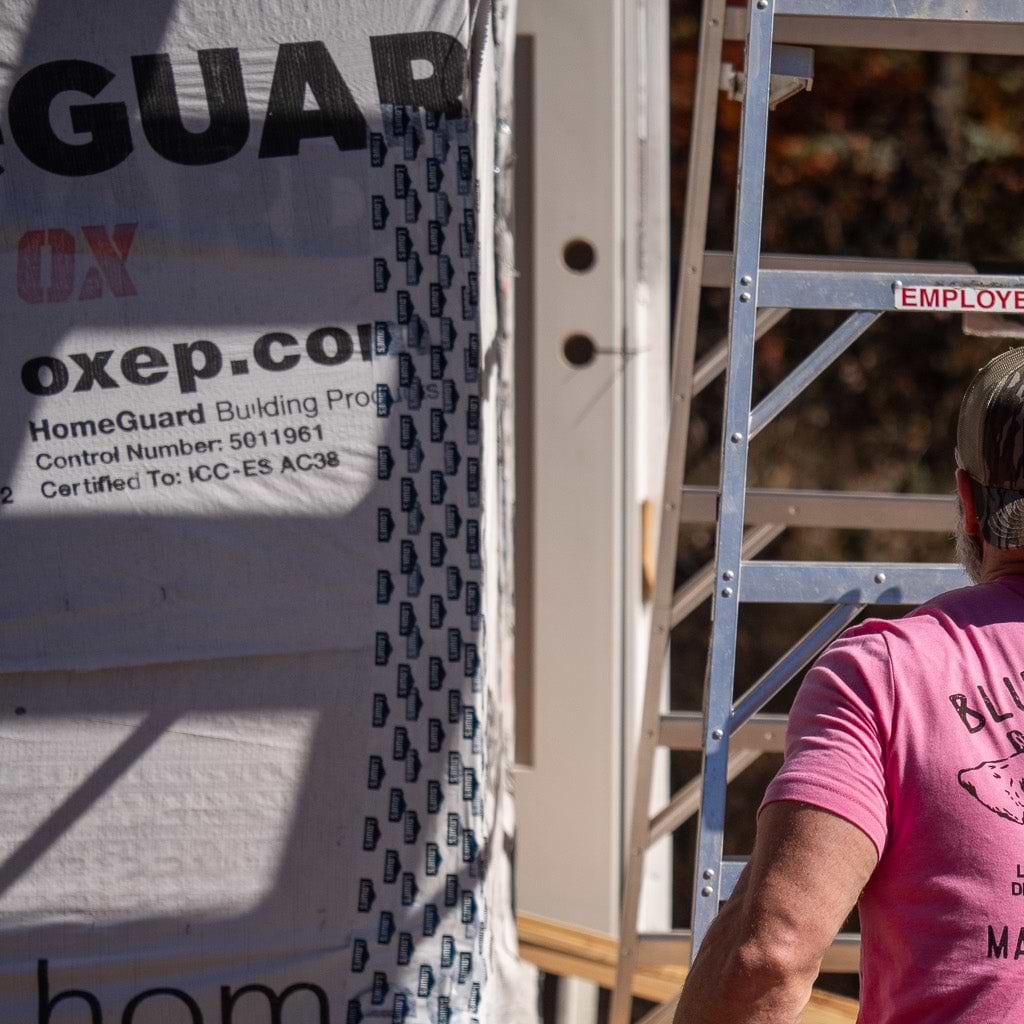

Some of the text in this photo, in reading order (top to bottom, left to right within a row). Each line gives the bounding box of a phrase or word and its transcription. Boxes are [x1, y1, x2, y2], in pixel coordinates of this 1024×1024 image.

[0, 31, 467, 177] GUAR
[16, 222, 138, 303] OX
[29, 403, 206, 442] HomeGuard
[215, 396, 319, 424] Building
[36, 424, 324, 471] Control Number: 5011961
[41, 451, 341, 499] Certified To: ICC-ES AC38
